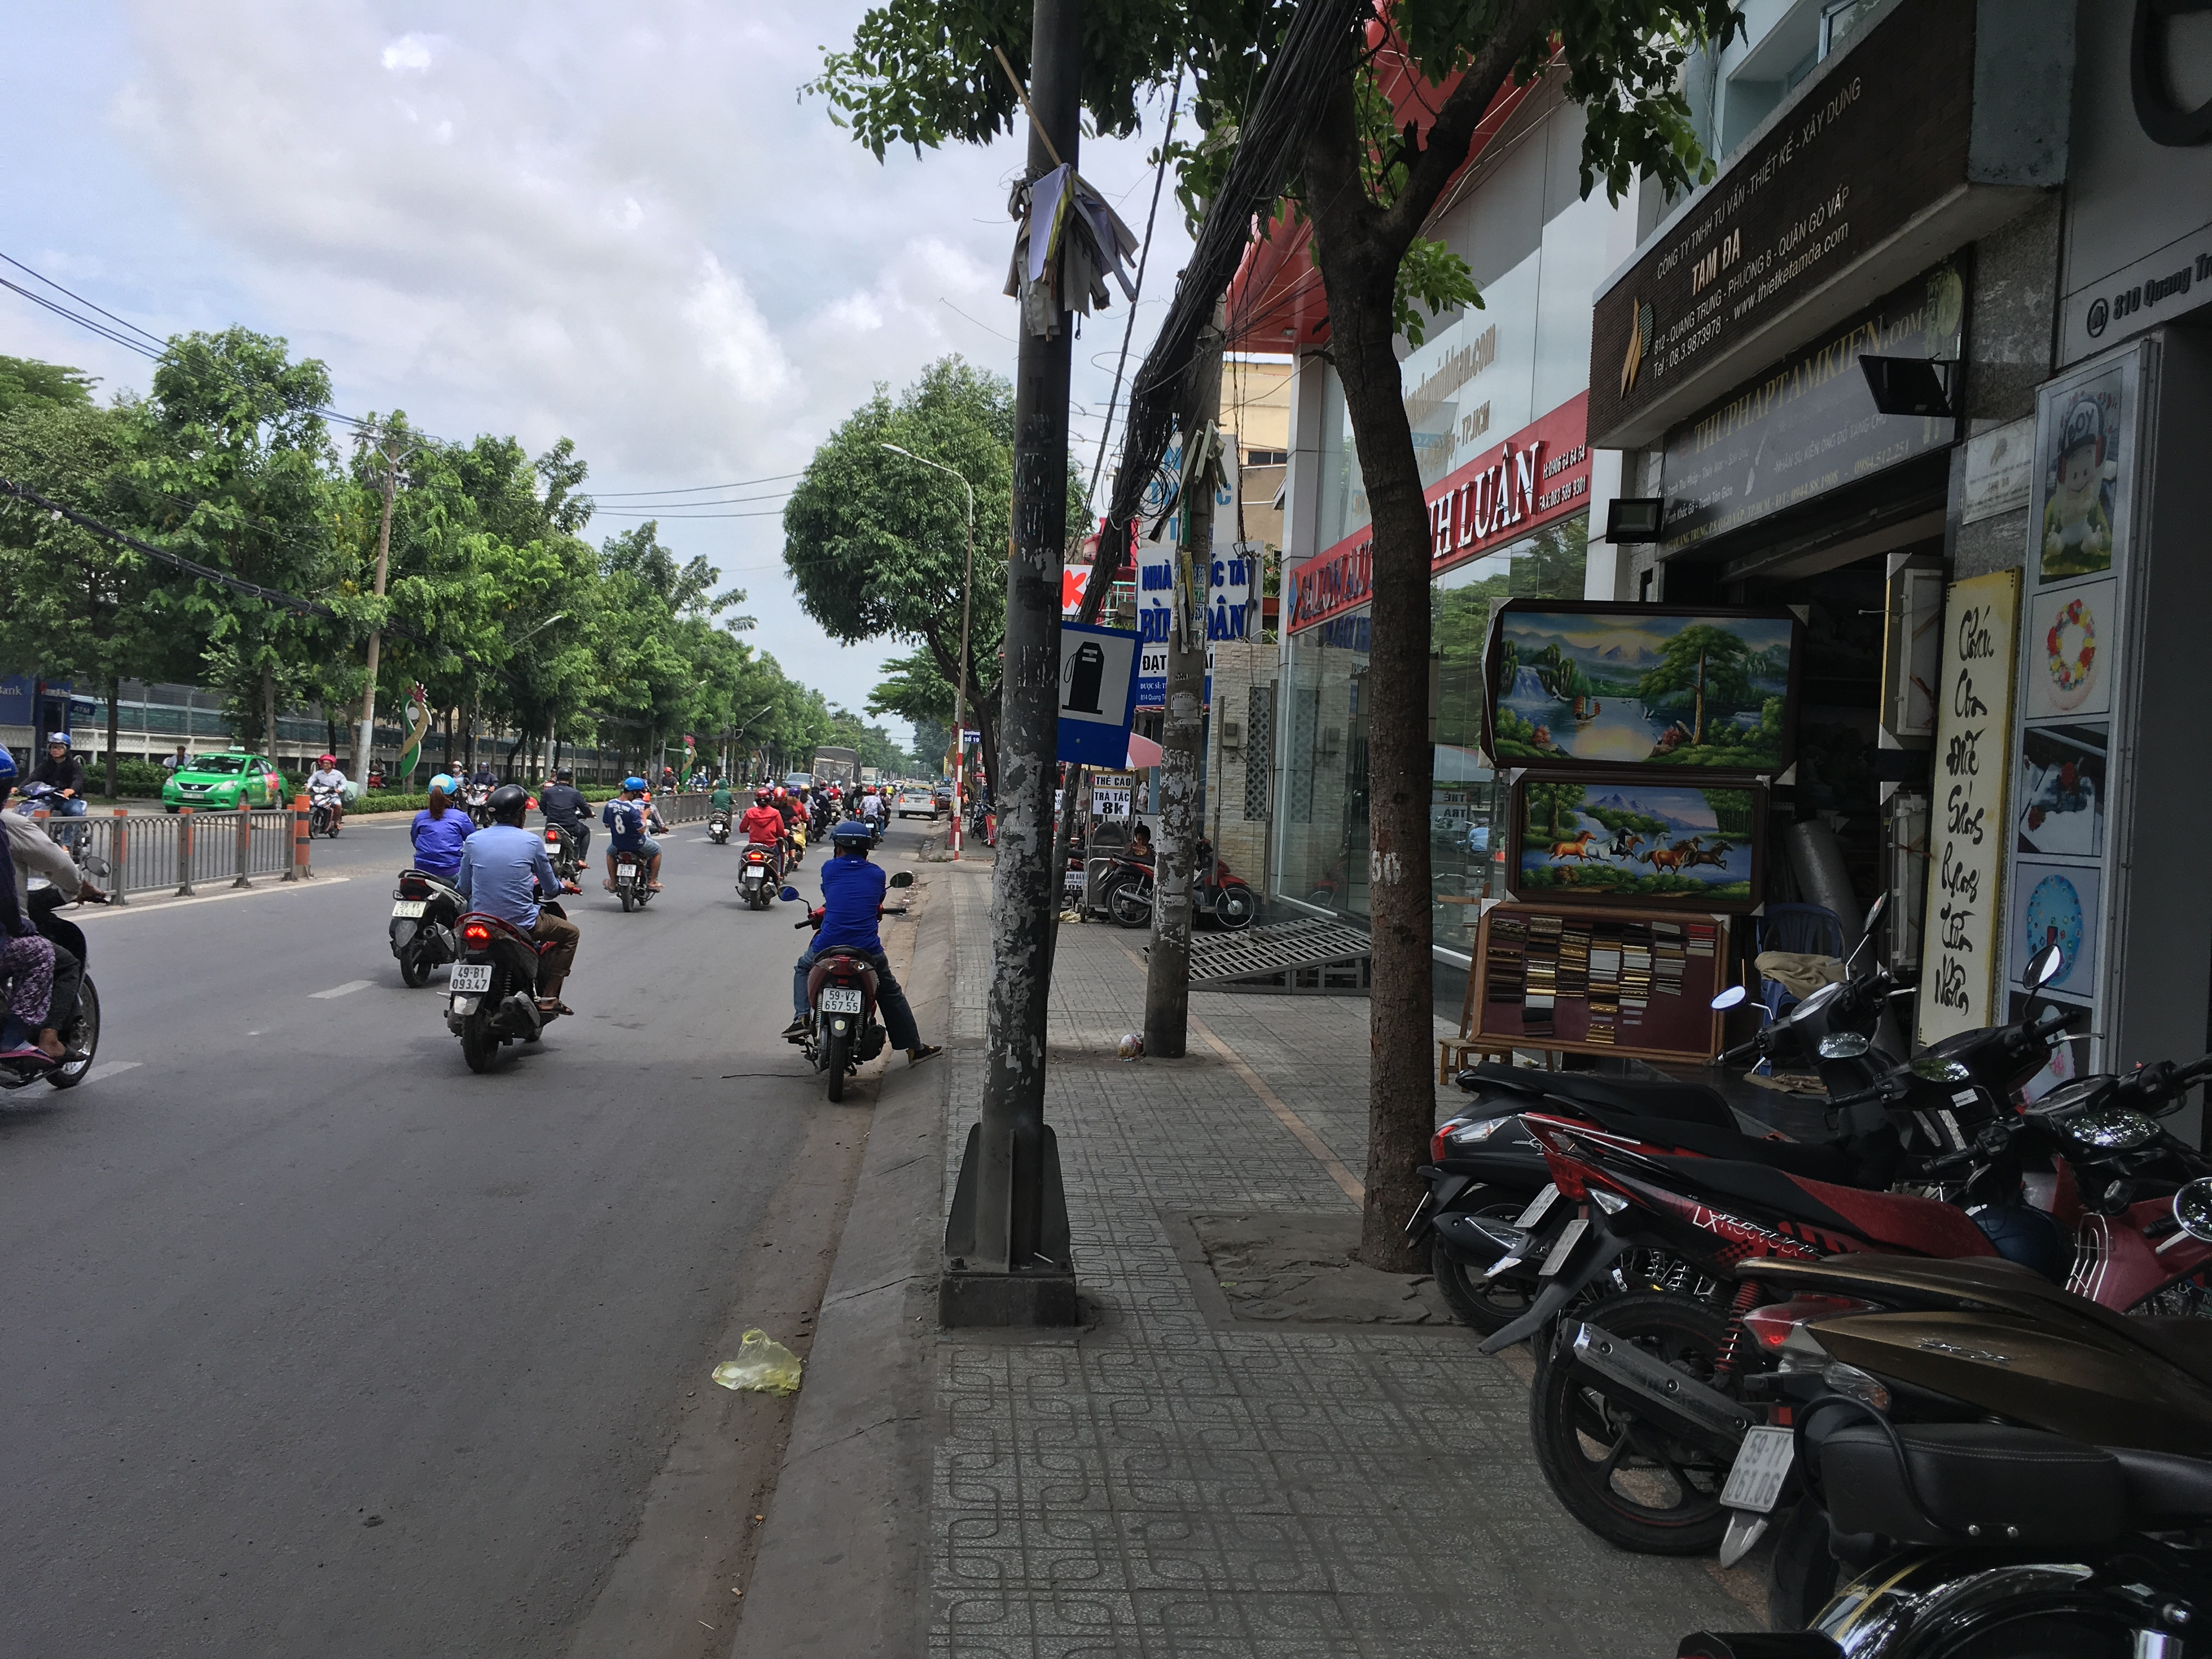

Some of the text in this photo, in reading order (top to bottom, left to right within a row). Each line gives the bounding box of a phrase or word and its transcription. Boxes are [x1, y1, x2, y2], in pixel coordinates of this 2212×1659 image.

[1657, 248, 1678, 279] CÔNG
[1680, 236, 1690, 259] TY
[1691, 216, 1712, 249] TNHH
[1727, 183, 1745, 216] VẤN
[1802, 110, 1824, 148] XÂY
[1654, 334, 1666, 355] 812
[1670, 311, 1695, 342] QUANG
[1697, 289, 1722, 321] TRUNG
[1766, 249, 1771, 267] 8
[1779, 219, 1807, 256] QUẬN
[1827, 183, 1849, 218] VẤP
[1692, 228, 1741, 296] TAM ĐA
[1669, 315, 1721, 367] 08.3.9873978
[1734, 222, 1849, 320] www.thietketamda.com
[2113, 286, 2141, 320] 810
[2143, 266, 2192, 307] Quang
[1142, 559, 1172, 591] NHÀ
[1096, 775, 1131, 786] THẺ CÀO
[1094, 790, 1129, 802] TRÀ TẮC
[1102, 802, 1124, 814] 8k
[615, 814, 626, 834] 8
[458, 967, 484, 979] 49-B1
[452, 979, 487, 990] 093.47
[830, 991, 856, 1001] 59-V2
[825, 1001, 858, 1012] 657.55
